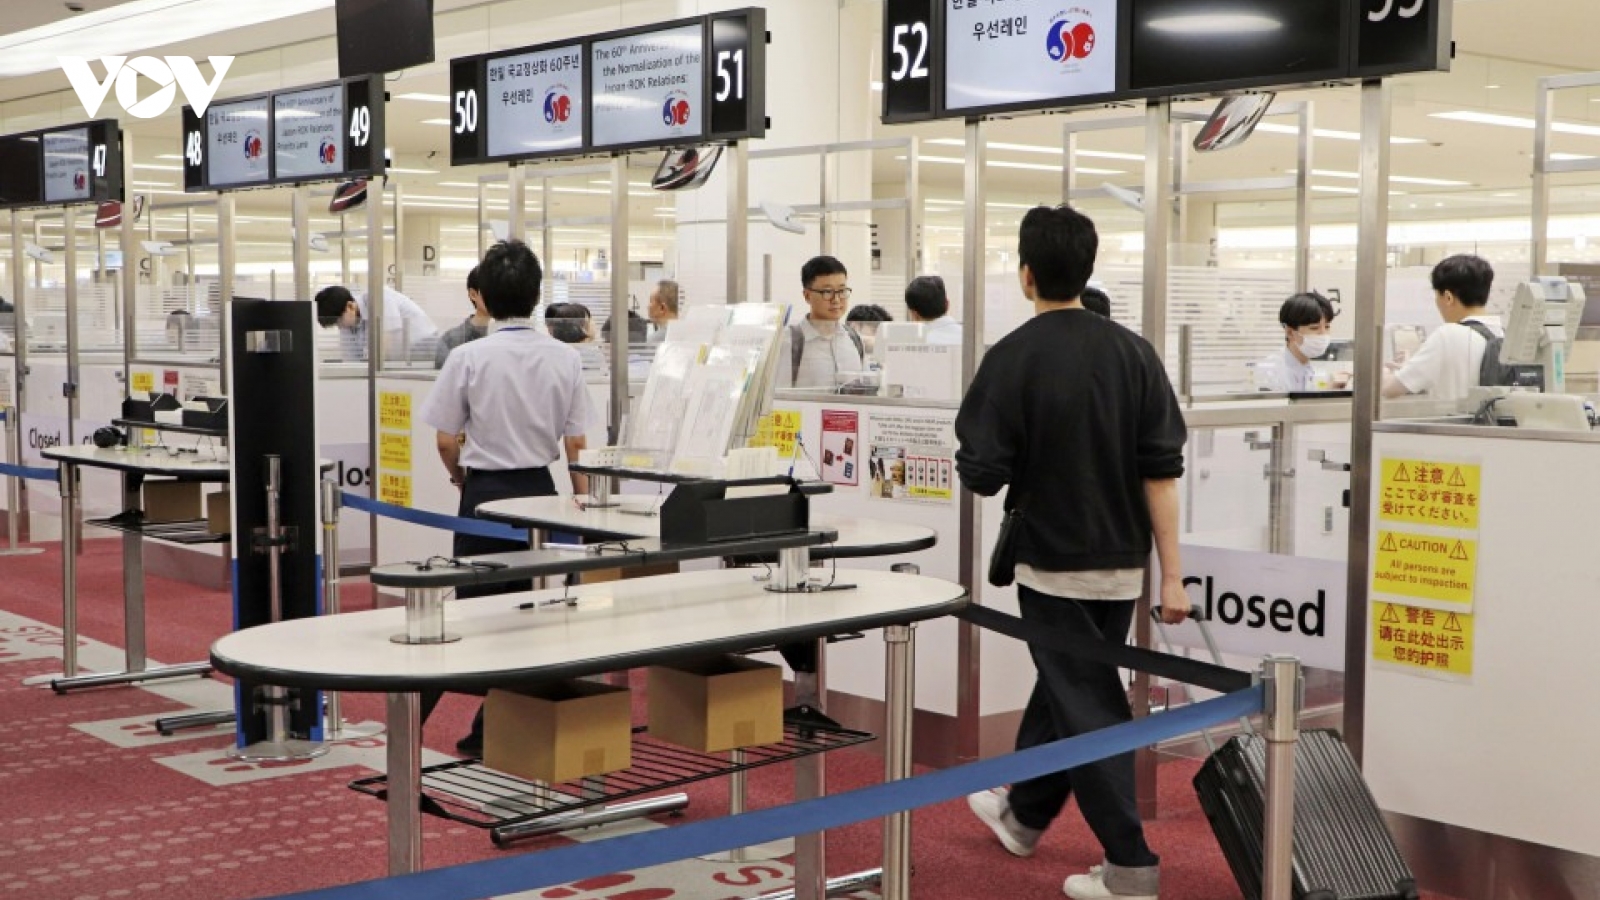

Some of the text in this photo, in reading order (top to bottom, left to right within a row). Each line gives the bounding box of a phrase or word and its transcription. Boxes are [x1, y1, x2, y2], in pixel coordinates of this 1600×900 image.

[973, 15, 1028, 42] 우선레인
[595, 48, 610, 60] The
[892, 21, 928, 81] 52
[602, 52, 700, 77] the Normalization of the
[716, 48, 743, 102] 51
[501, 88, 534, 106] 우선레인
[455, 89, 477, 134] 50
[350, 105, 370, 147] 49
[186, 130, 202, 166] 48
[93, 144, 107, 177] 47
[422, 245, 436, 262] D
[1414, 465, 1444, 485] 注意
[1384, 485, 1477, 507] ここで必ず審査を
[1399, 539, 1448, 554] CAUTION
[1374, 570, 1406, 583] subject
[1409, 574, 1418, 584] to
[1389, 558, 1456, 577] All persons are
[1181, 575, 1326, 637] Closed
[1405, 606, 1436, 626] 警告
[1379, 625, 1465, 651] 请在此处出示
[1393, 645, 1450, 669] 您的护照
